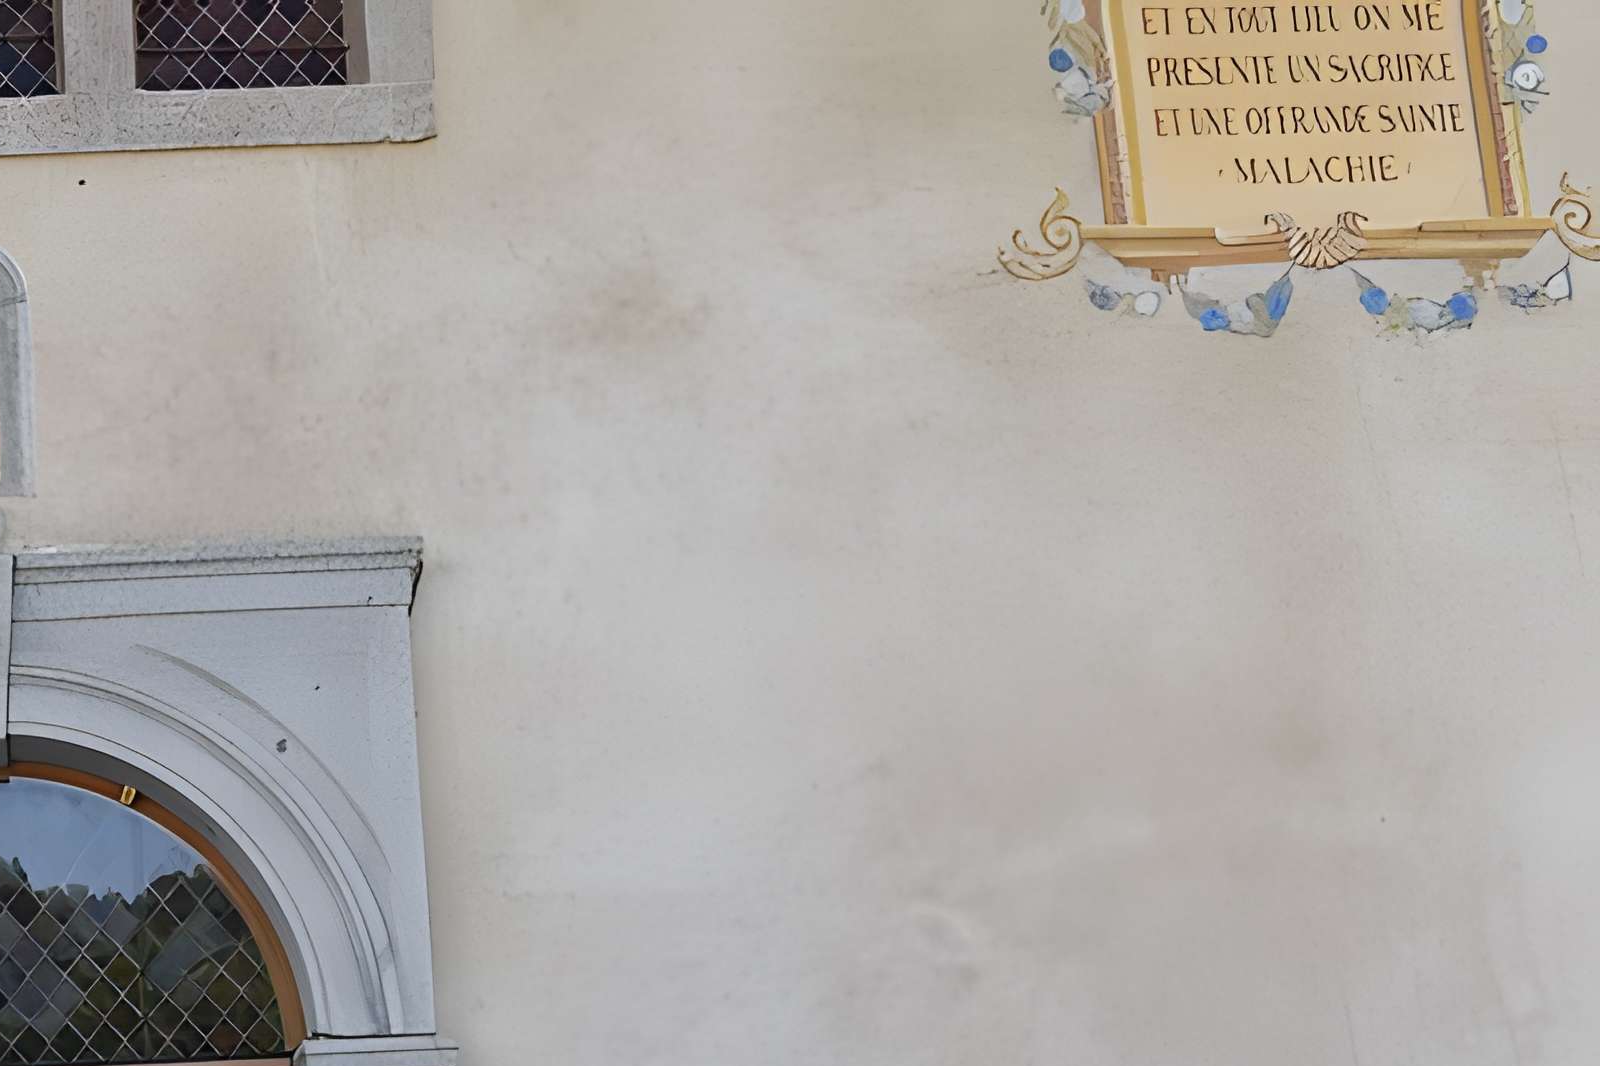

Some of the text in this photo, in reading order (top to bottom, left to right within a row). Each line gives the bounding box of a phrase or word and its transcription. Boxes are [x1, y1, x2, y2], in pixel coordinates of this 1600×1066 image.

[1141, 6, 1175, 36] ET
[1354, 4, 1391, 31] ON
[1154, 107, 1182, 137] ET
